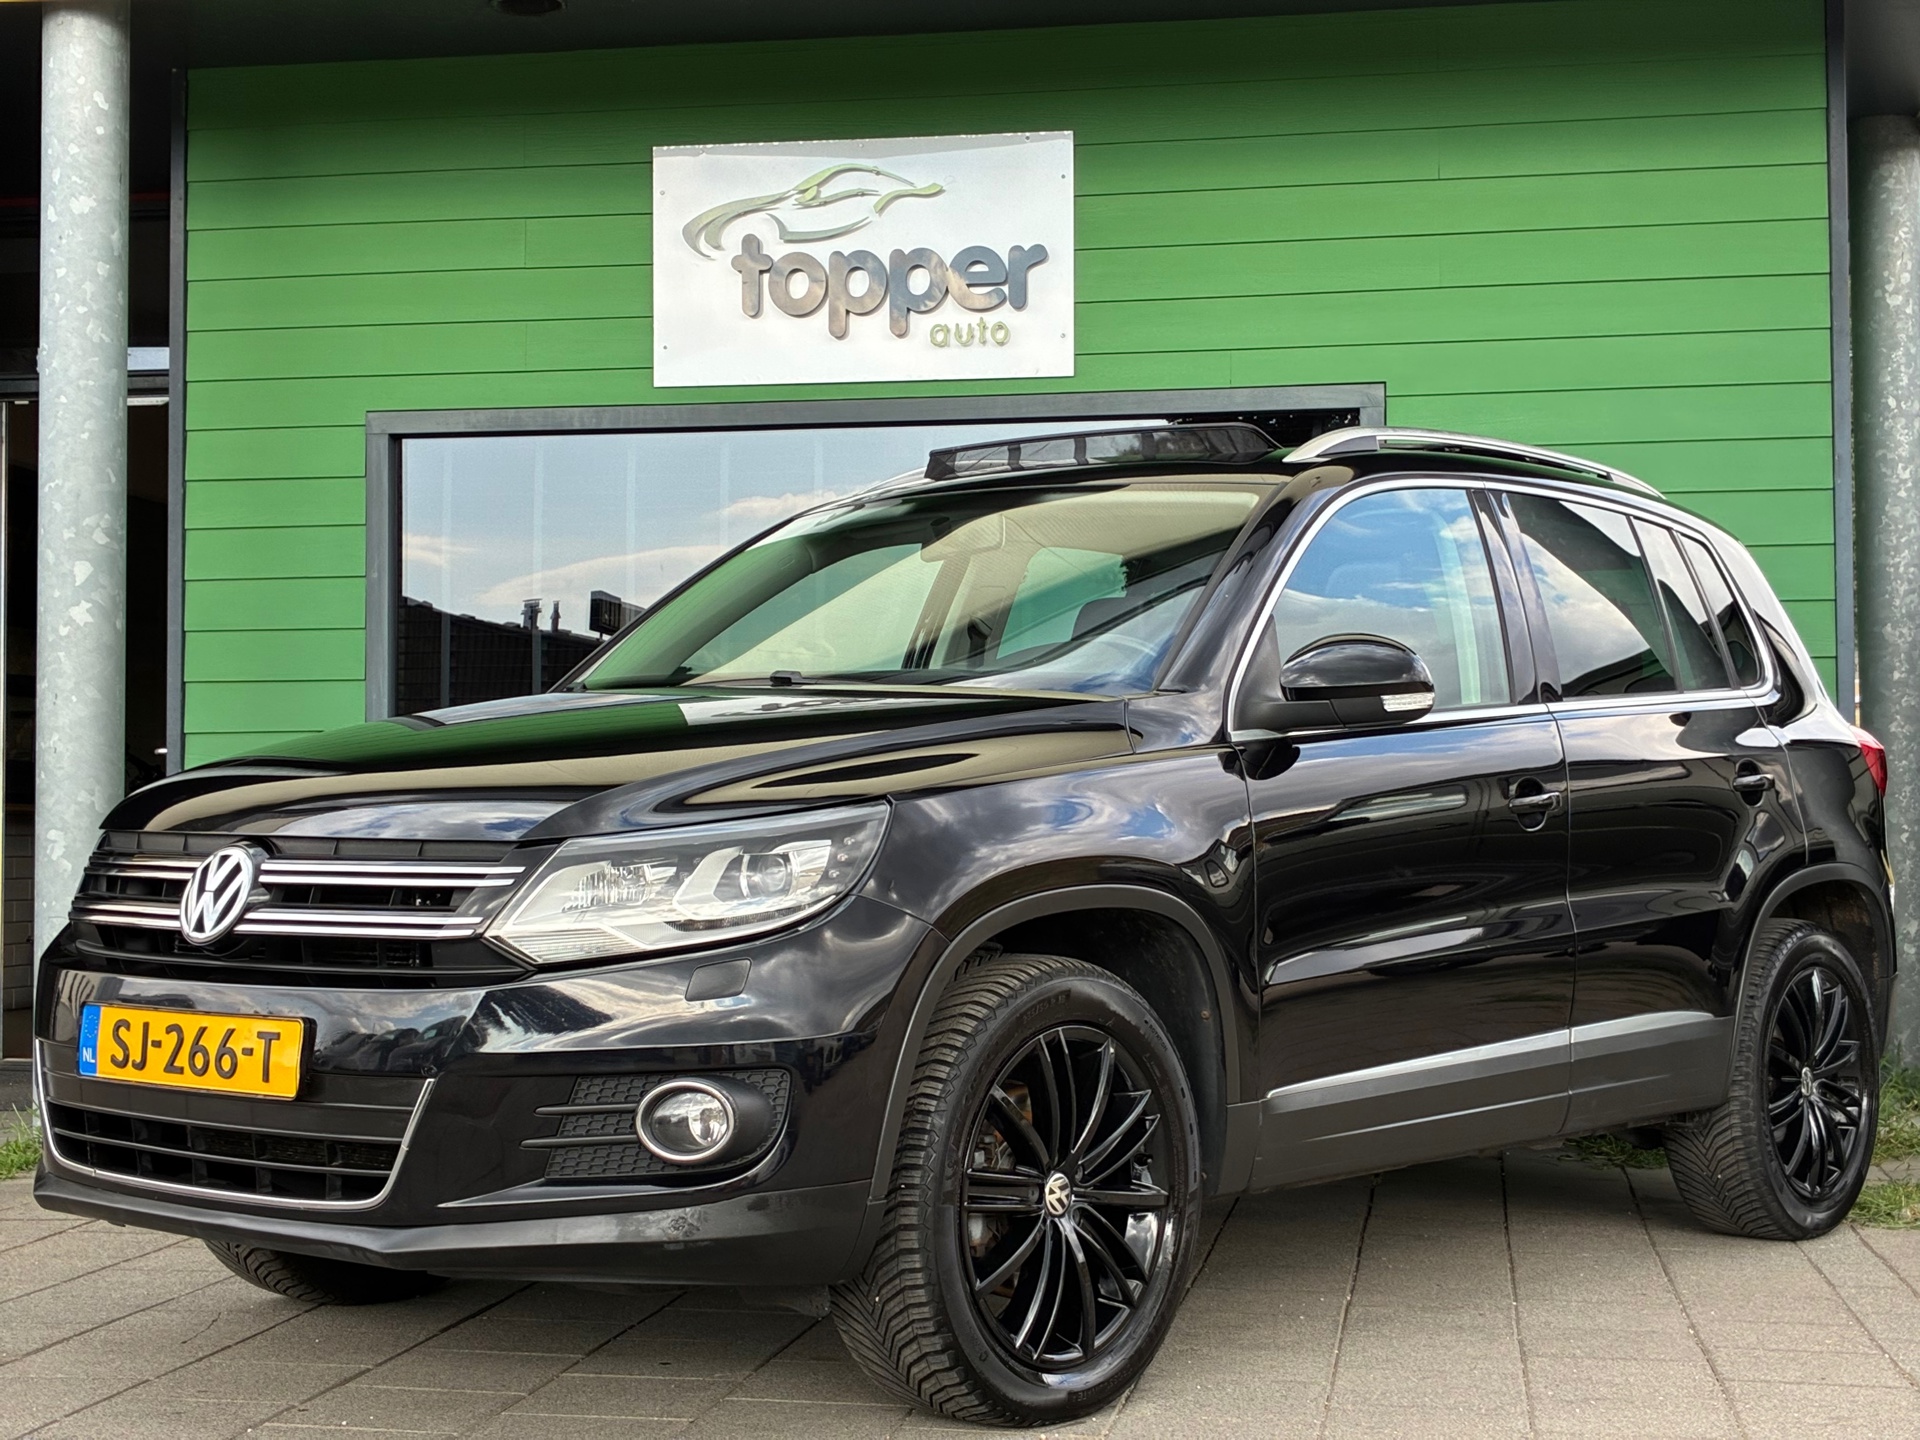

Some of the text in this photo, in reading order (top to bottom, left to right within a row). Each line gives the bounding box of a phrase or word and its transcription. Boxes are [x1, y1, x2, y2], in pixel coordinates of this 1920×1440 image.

[730, 233, 1048, 338] topper
[929, 317, 1011, 347] auto
[183, 849, 250, 941] VW
[82, 1047, 96, 1064] NL
[110, 1018, 281, 1084] SJ-266-T
